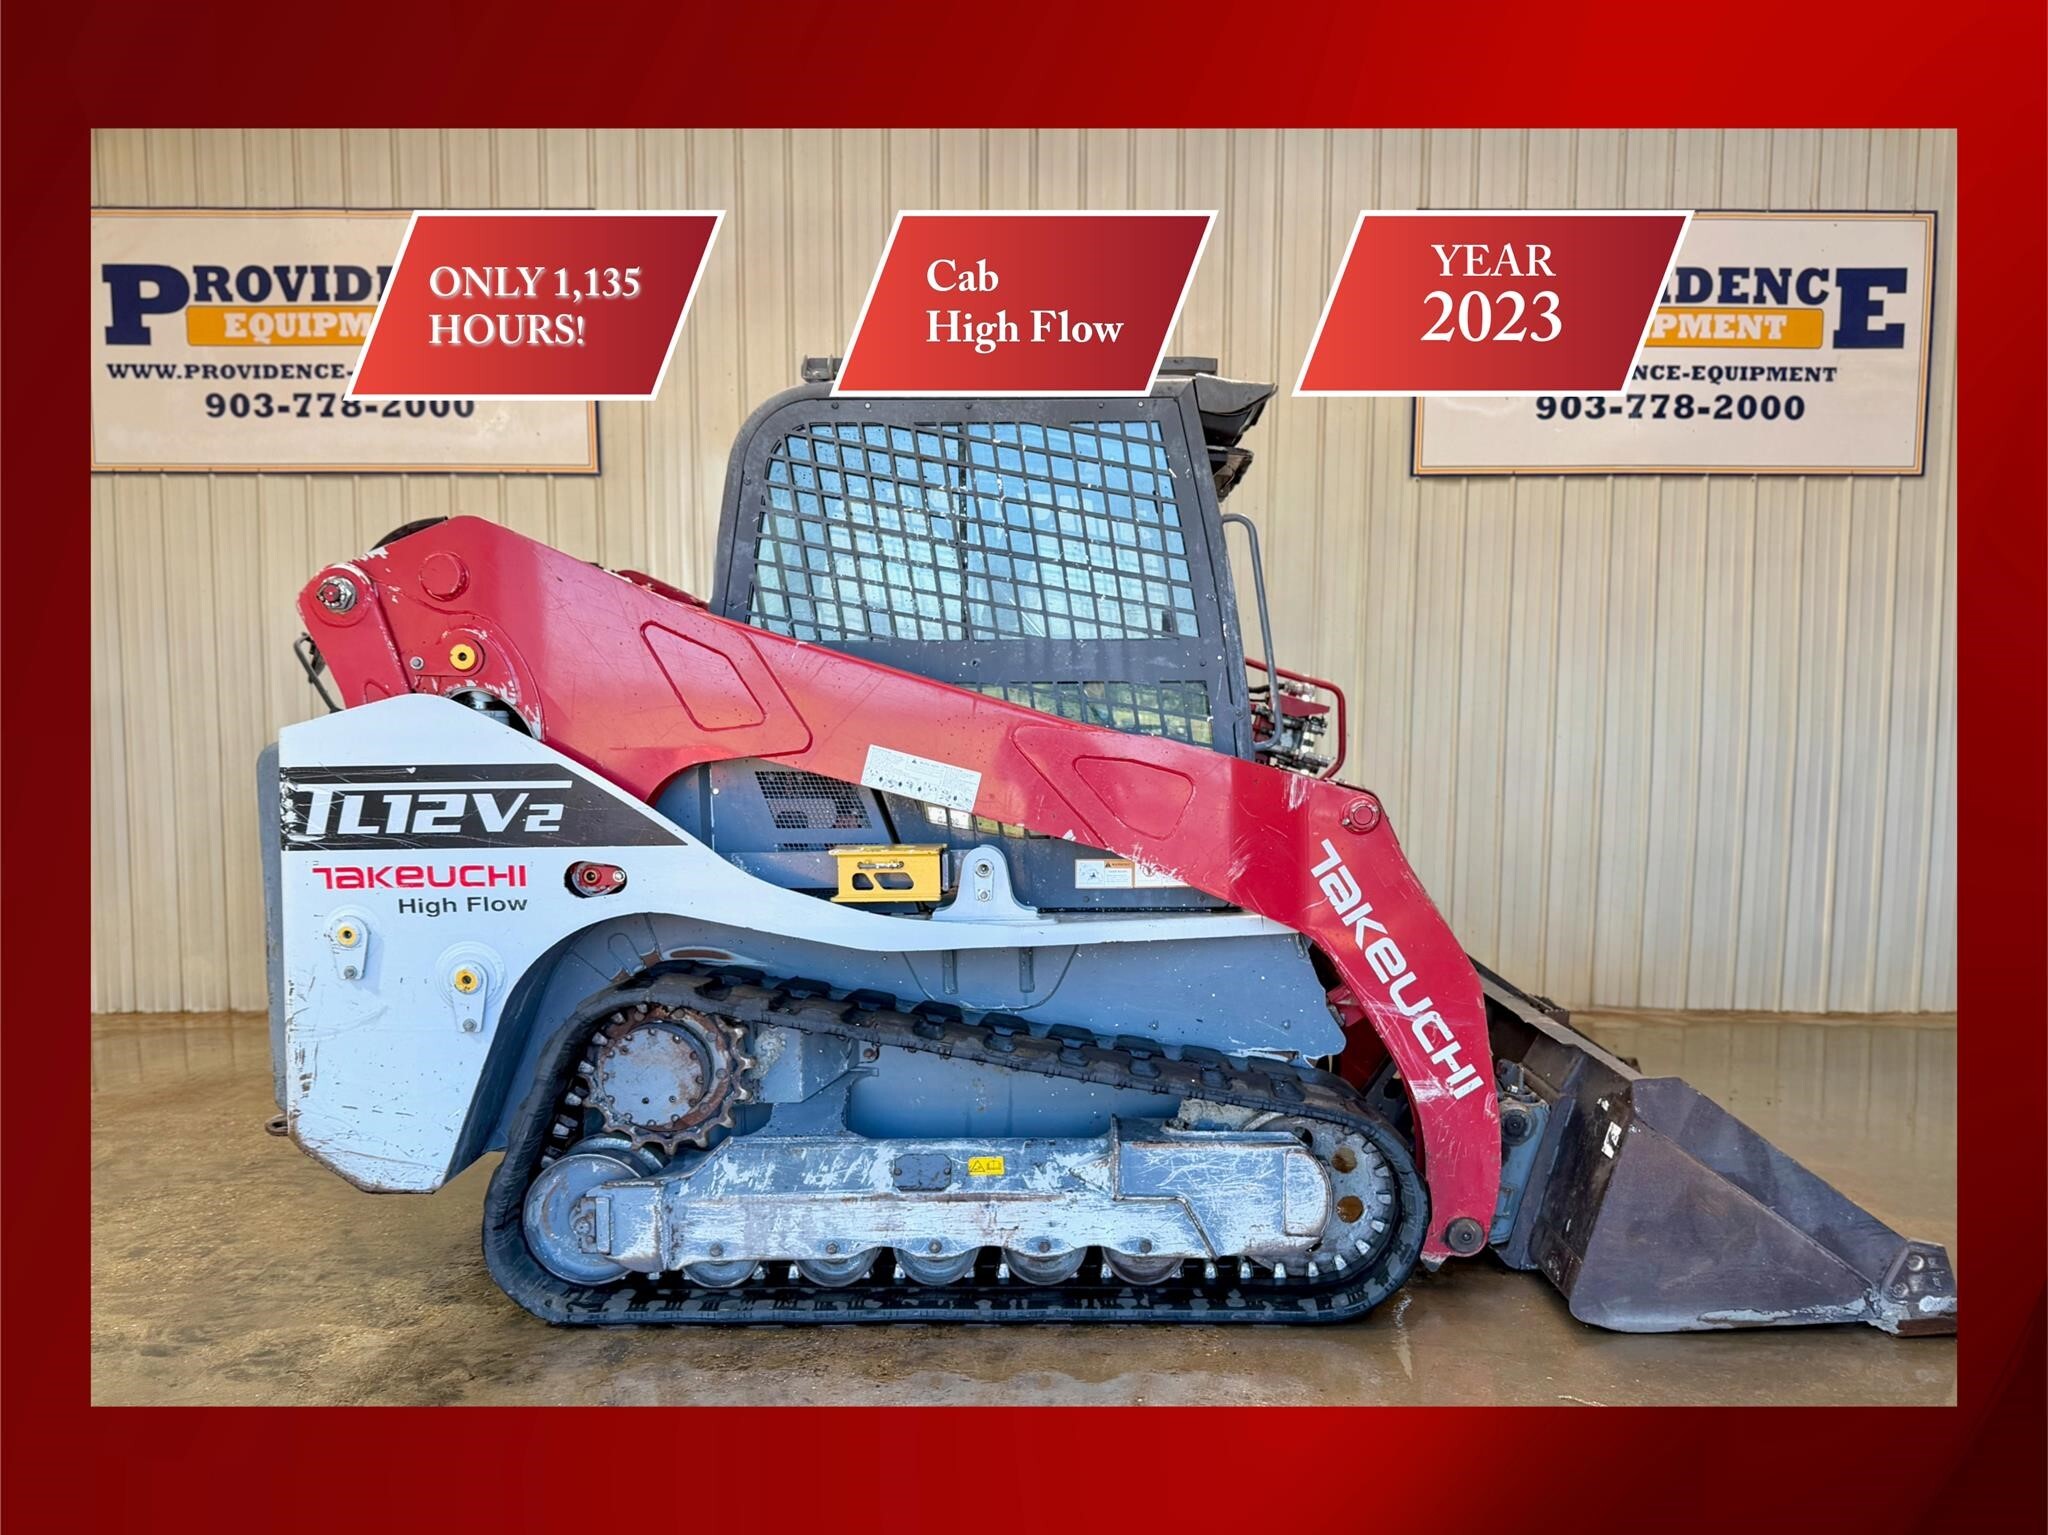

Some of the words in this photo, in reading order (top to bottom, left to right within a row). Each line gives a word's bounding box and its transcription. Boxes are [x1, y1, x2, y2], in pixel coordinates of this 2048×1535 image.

[205, 392, 475, 419] 903-778-2000
[1535, 394, 1806, 421] 903-778-2000
[398, 897, 457, 917] High
[467, 896, 528, 912] Flow
